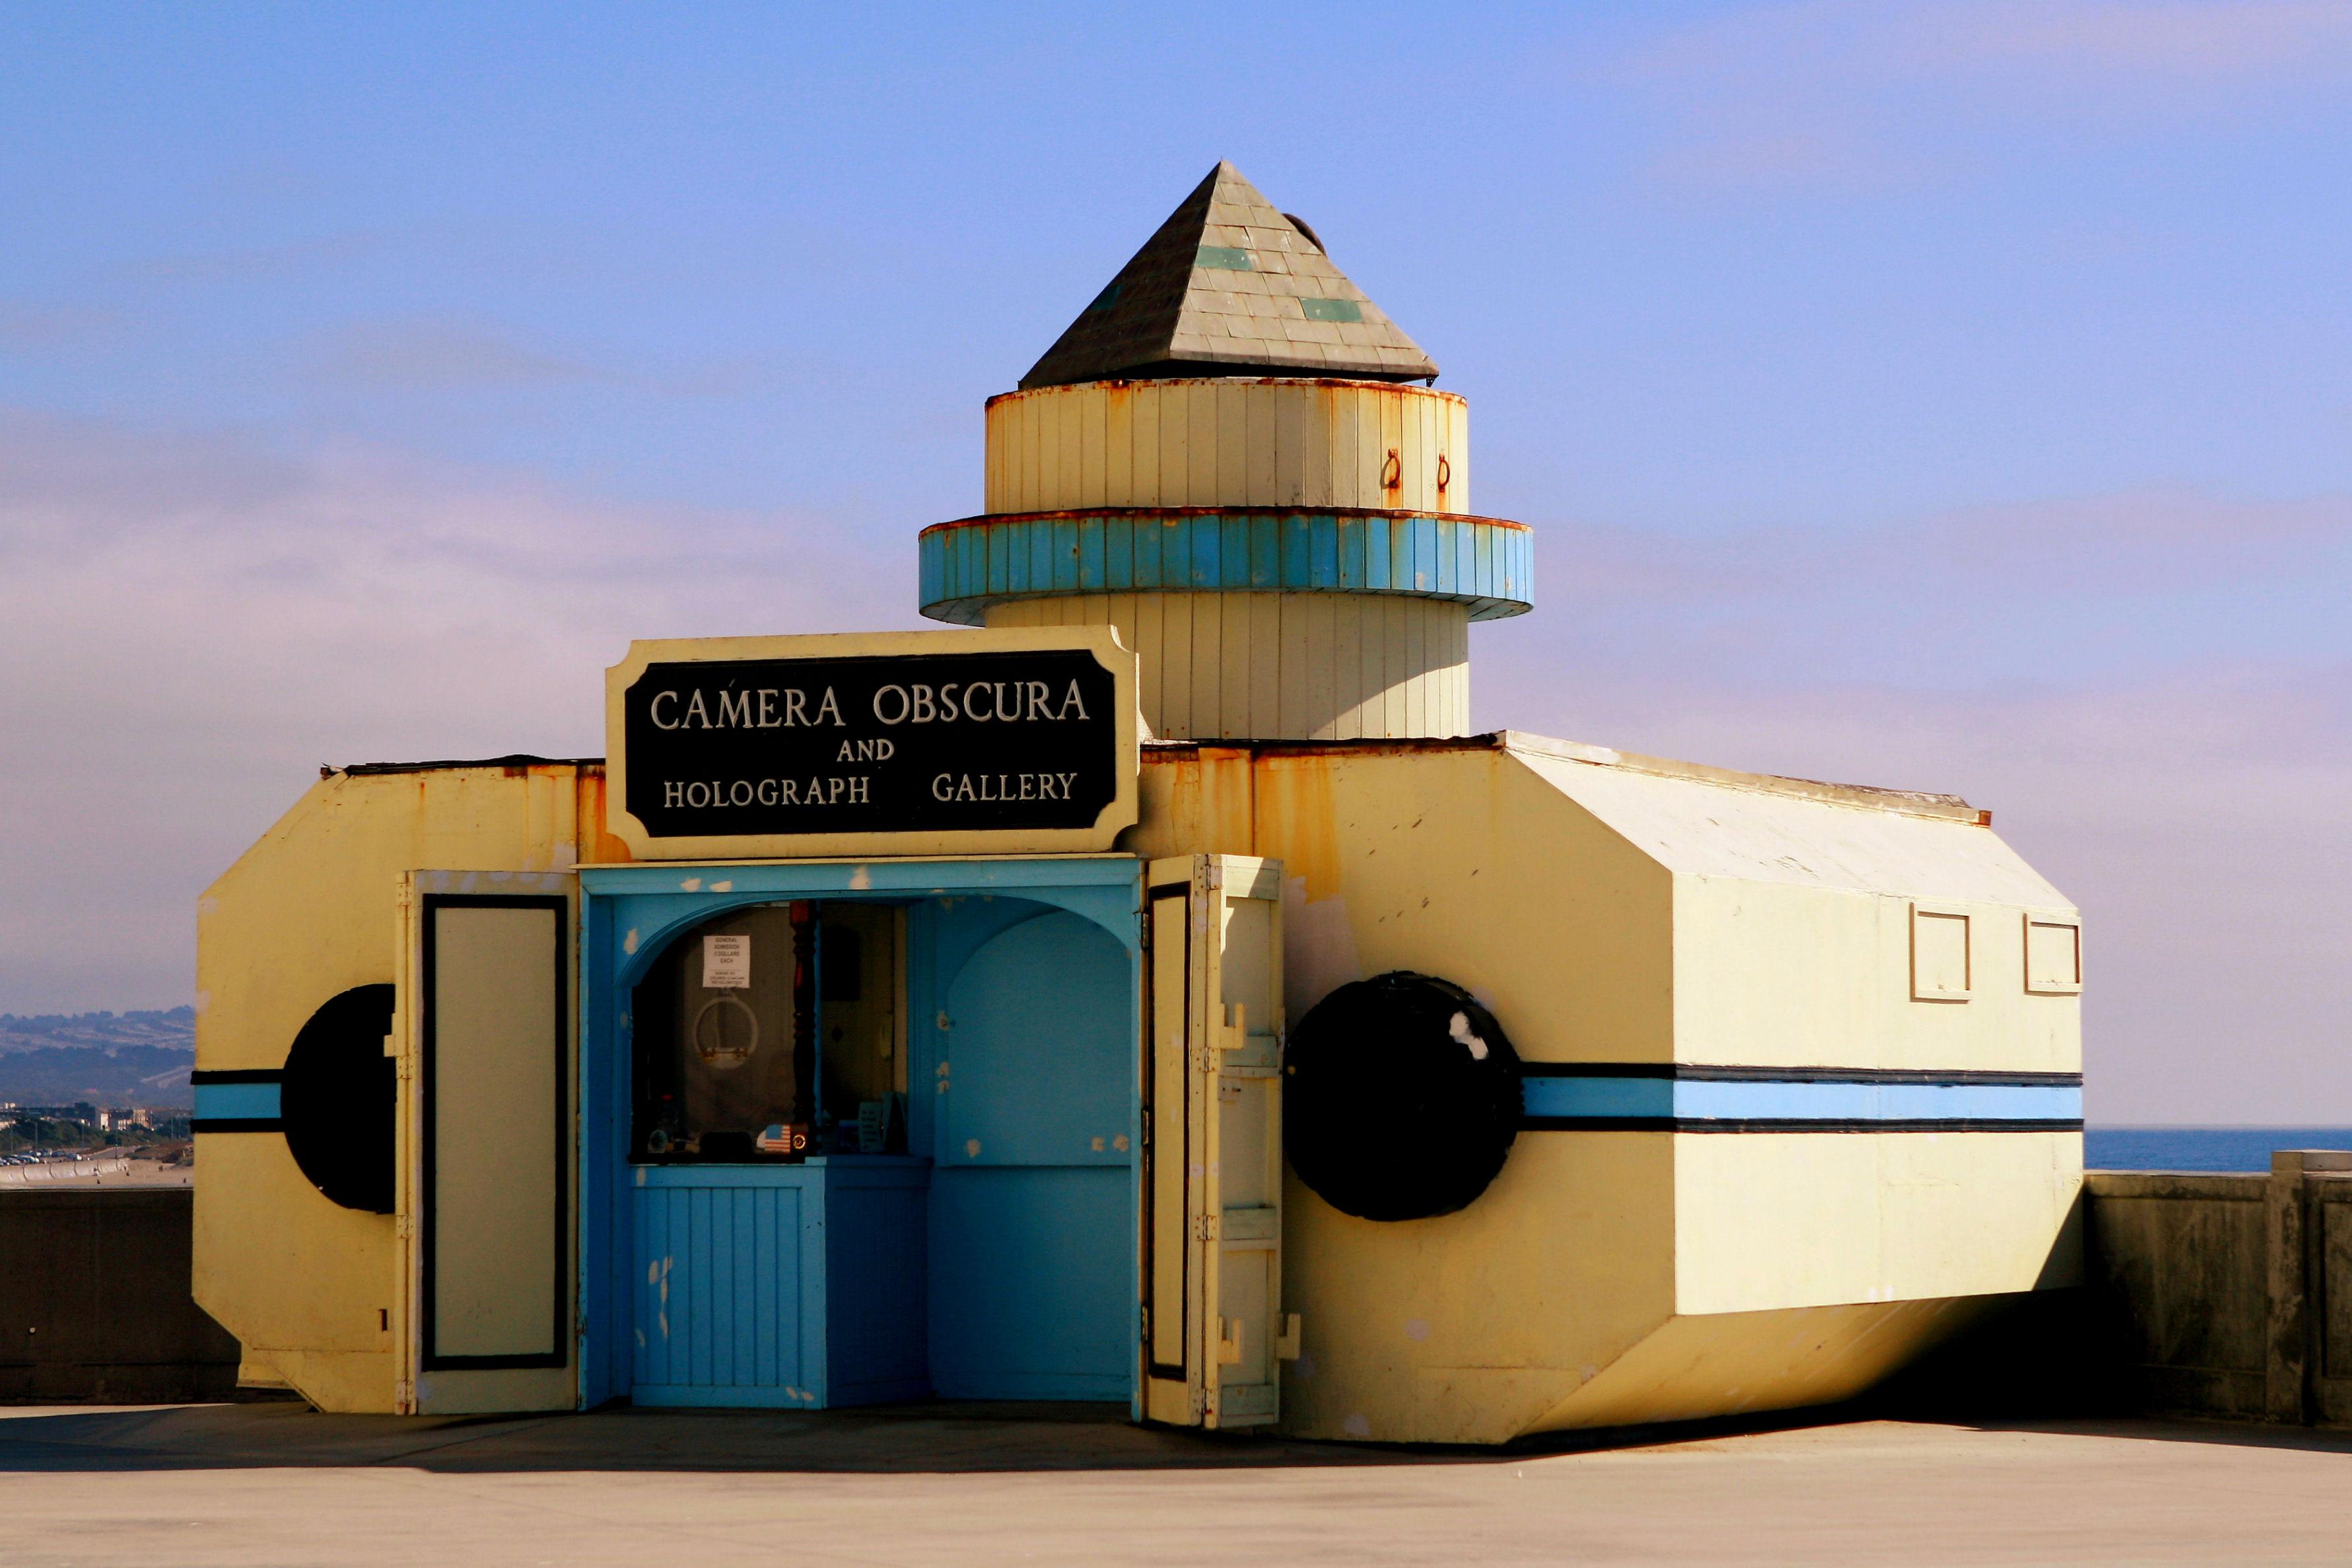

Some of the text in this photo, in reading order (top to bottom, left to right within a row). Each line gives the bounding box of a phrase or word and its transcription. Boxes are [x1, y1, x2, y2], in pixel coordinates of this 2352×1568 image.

[650, 677, 1091, 730] CAMERA OBSCURA
[836, 738, 895, 762] AND
[663, 772, 1078, 809] HOLOGRAPH GALLERY
